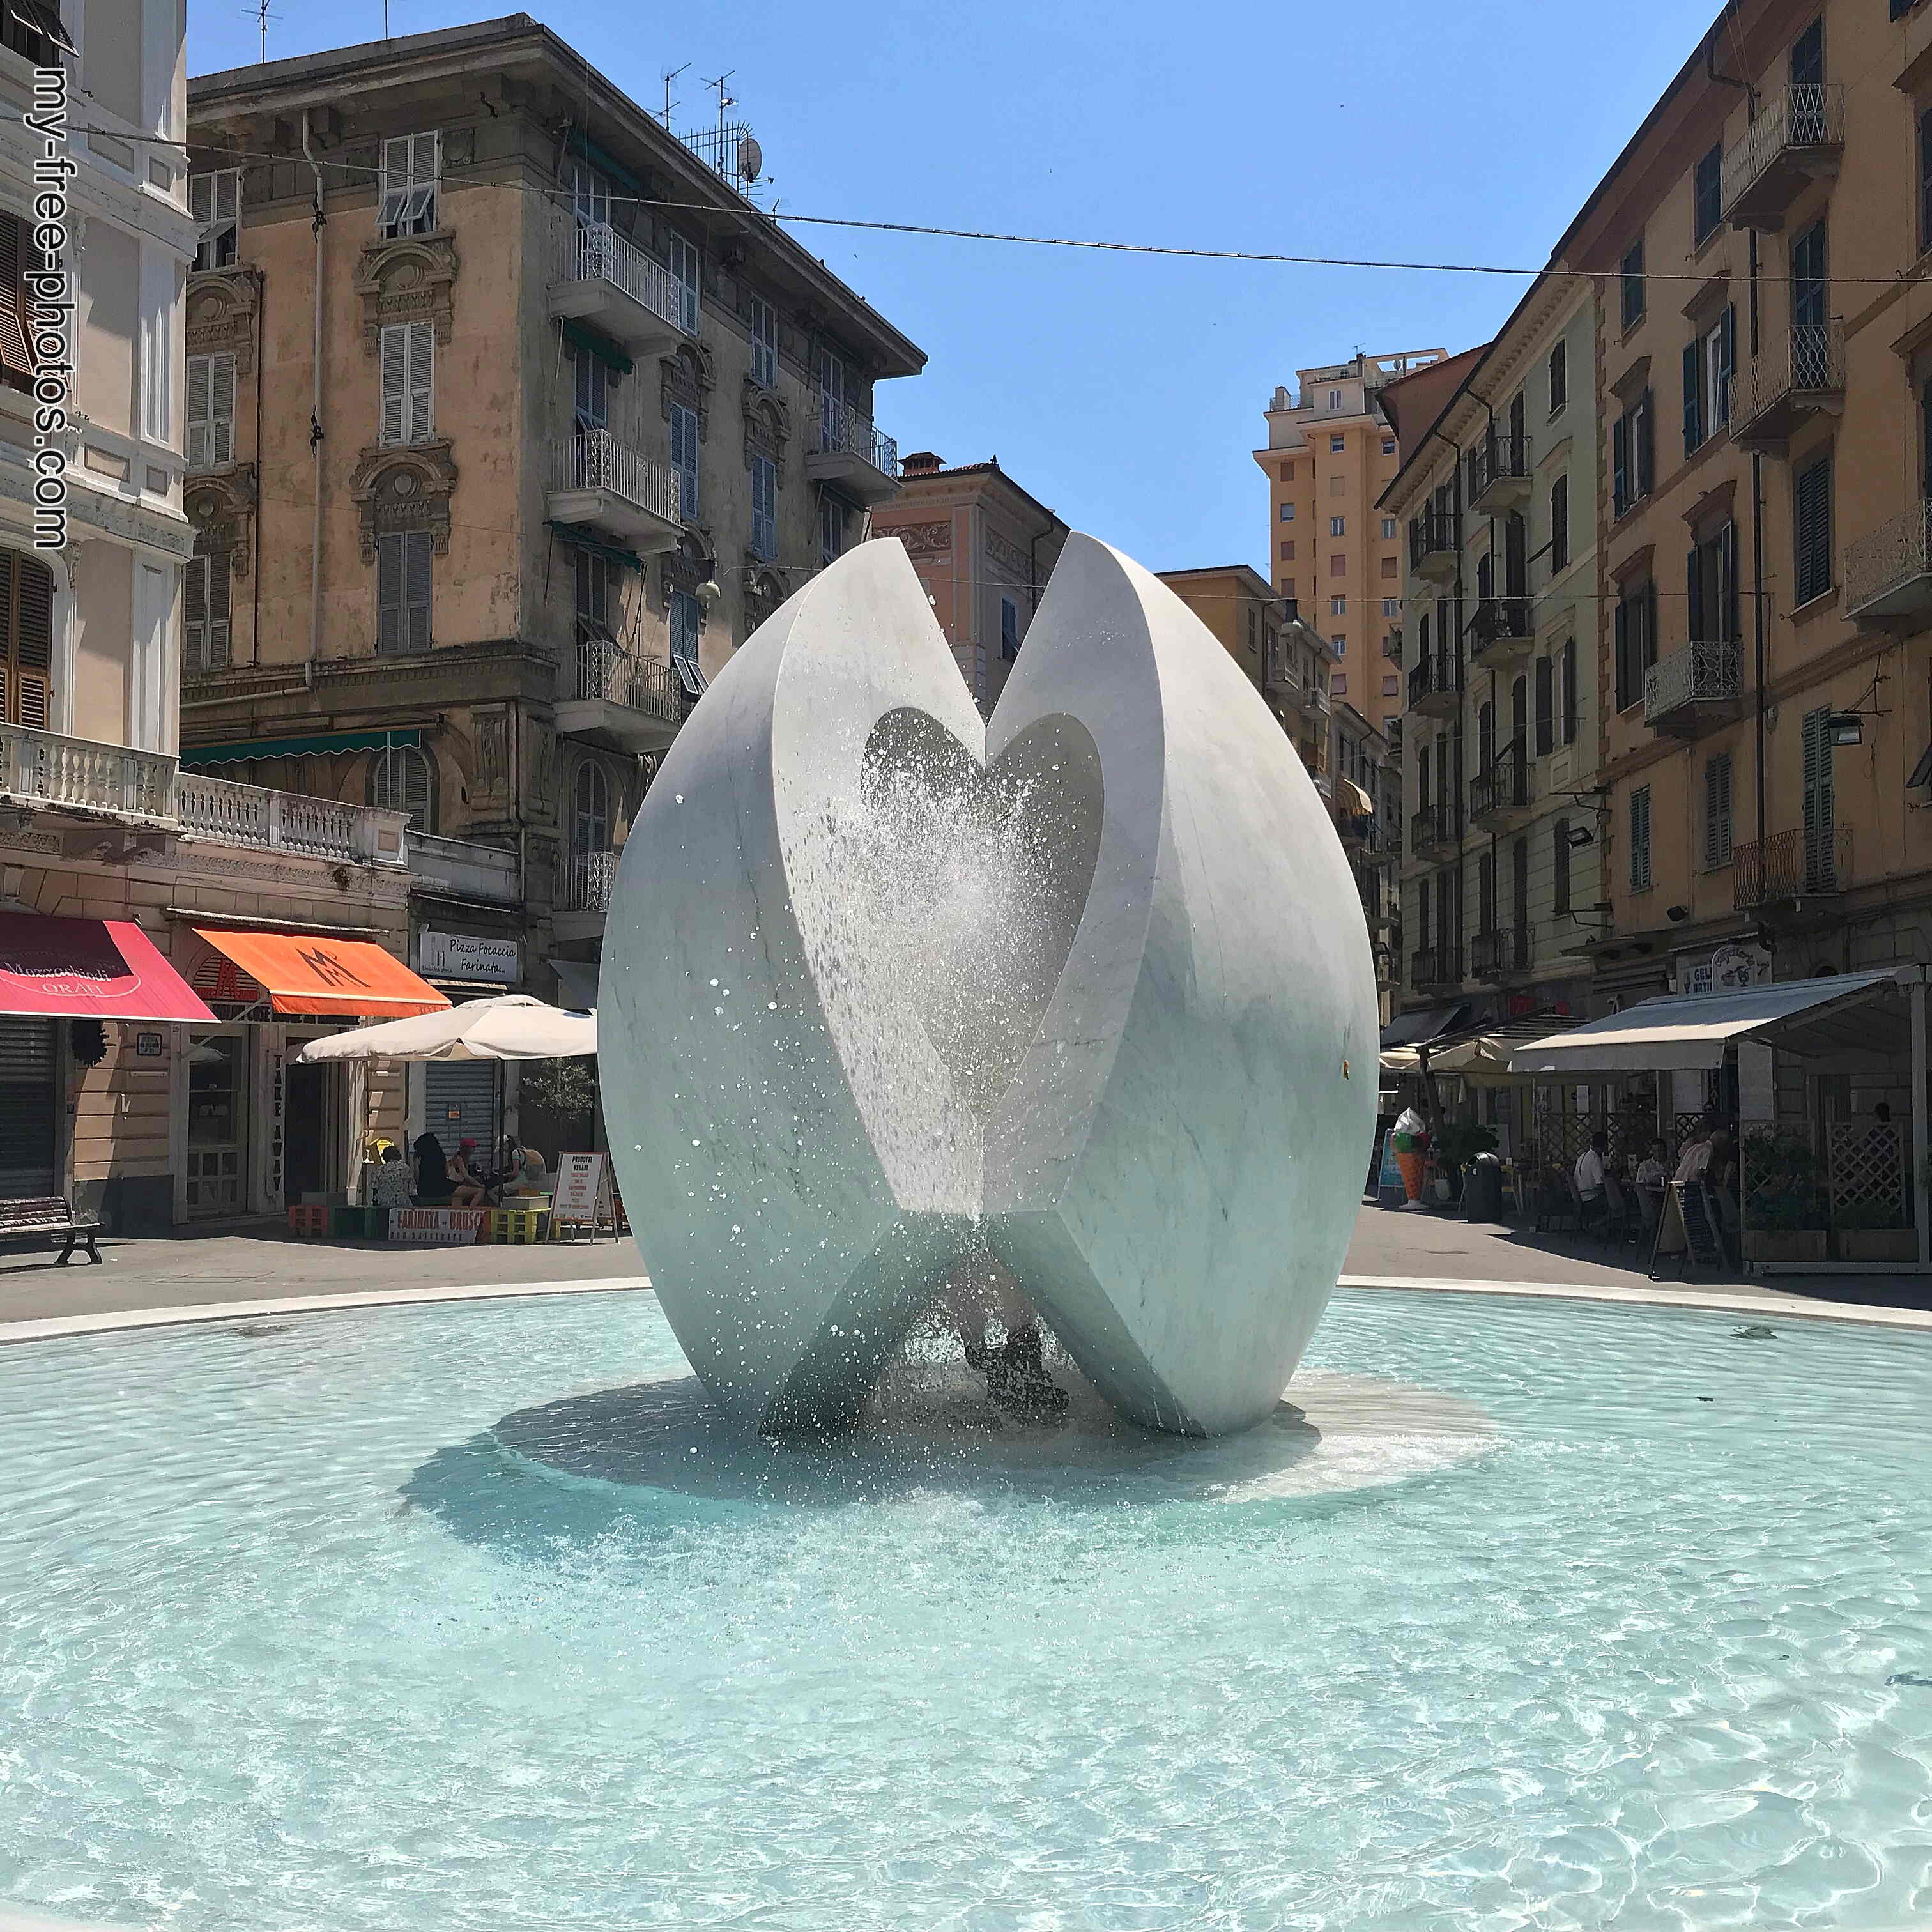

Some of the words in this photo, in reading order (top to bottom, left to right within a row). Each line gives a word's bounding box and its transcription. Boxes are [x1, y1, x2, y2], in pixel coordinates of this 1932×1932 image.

[450, 939, 477, 953] Pizza
[479, 942, 516, 958] Focaccia
[273, 1054, 283, 1117] TAKE
